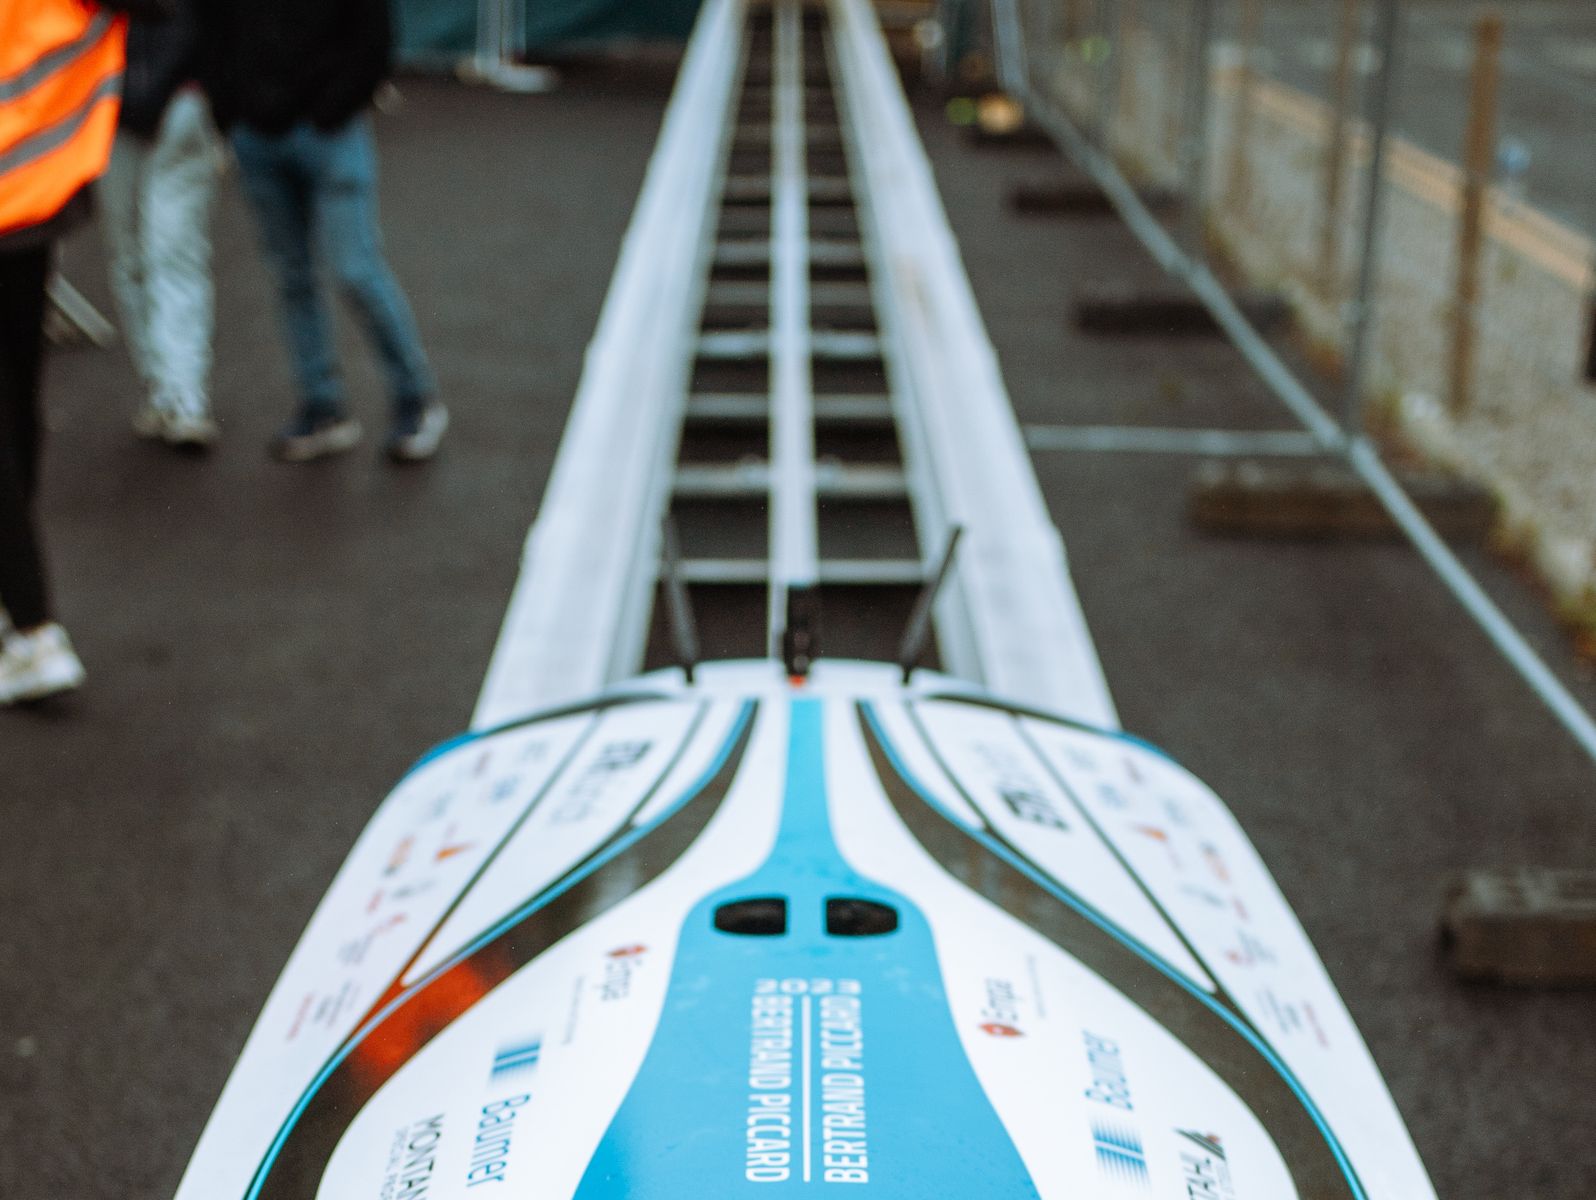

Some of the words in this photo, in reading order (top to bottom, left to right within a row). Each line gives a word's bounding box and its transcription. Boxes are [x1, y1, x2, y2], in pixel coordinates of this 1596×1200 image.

[748, 994, 794, 1090] BERTRAND
[820, 995, 864, 1071] PICCARD
[466, 1093, 532, 1188] Baumer
[745, 1093, 791, 1183] PICCARD
[821, 1072, 869, 1184] BERTRAND
